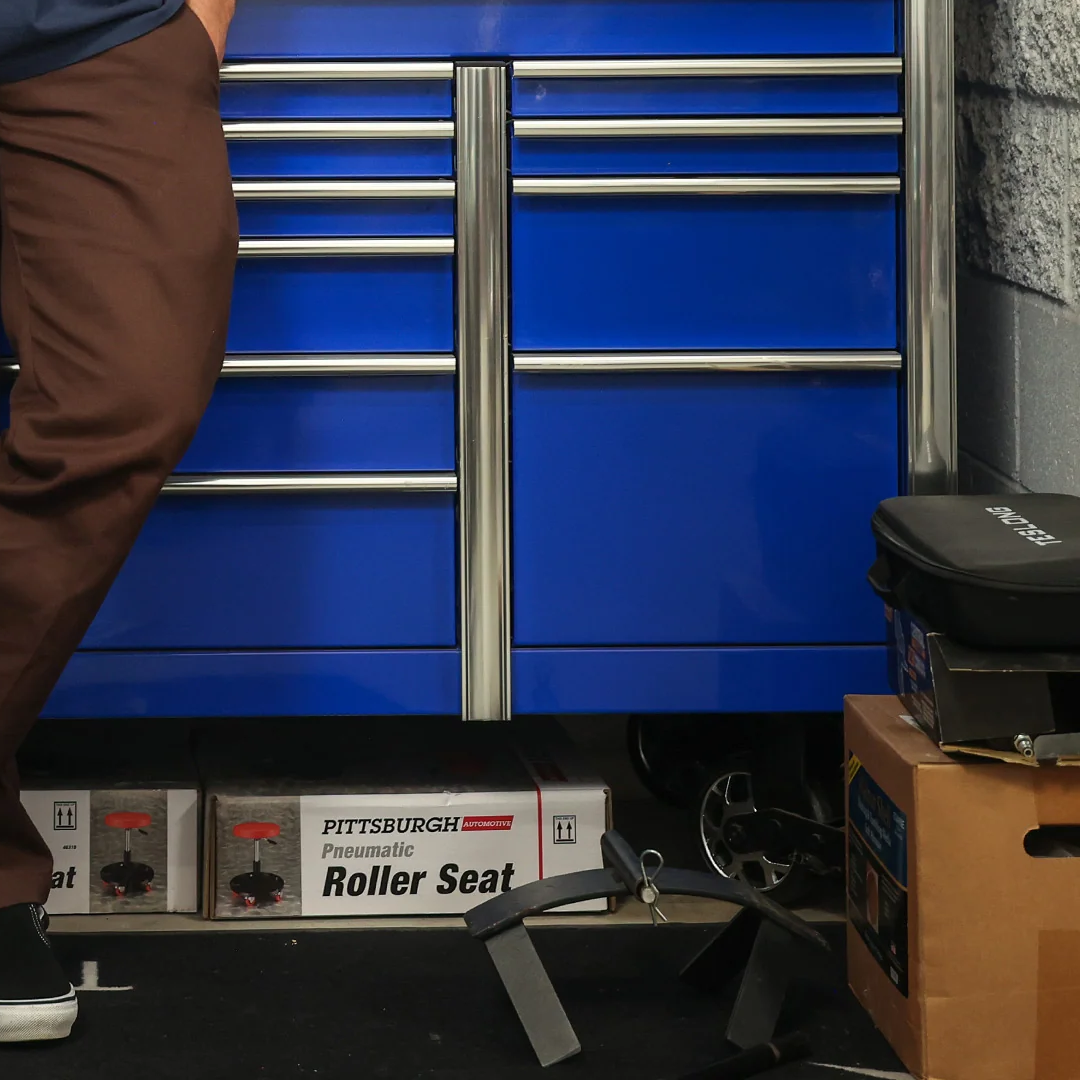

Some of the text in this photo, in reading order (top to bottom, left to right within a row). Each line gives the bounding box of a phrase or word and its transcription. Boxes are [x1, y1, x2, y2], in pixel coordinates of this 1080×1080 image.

[985, 507, 1062, 546] TESLONG
[322, 817, 512, 835] PITTSBURGH AUTOMOTIVE
[322, 842, 415, 859] Pneumatic
[322, 863, 515, 897] Roller Seat
